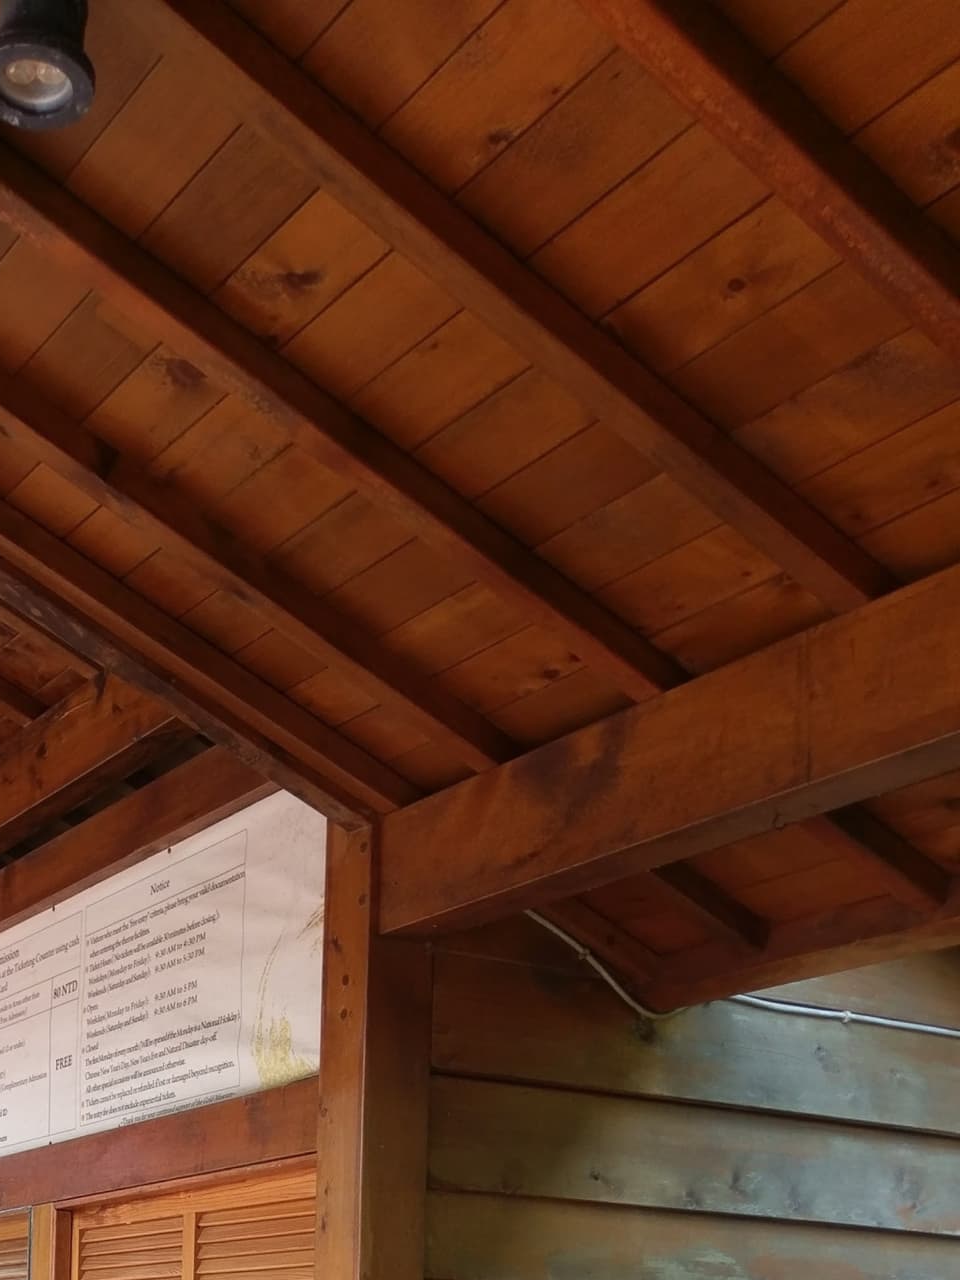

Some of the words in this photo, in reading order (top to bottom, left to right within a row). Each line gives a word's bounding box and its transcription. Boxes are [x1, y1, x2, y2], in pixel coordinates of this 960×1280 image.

[151, 880, 170, 895] Notice
[54, 987, 61, 999] 80
[62, 980, 78, 996] NTD
[56, 1055, 72, 1070] FREE
